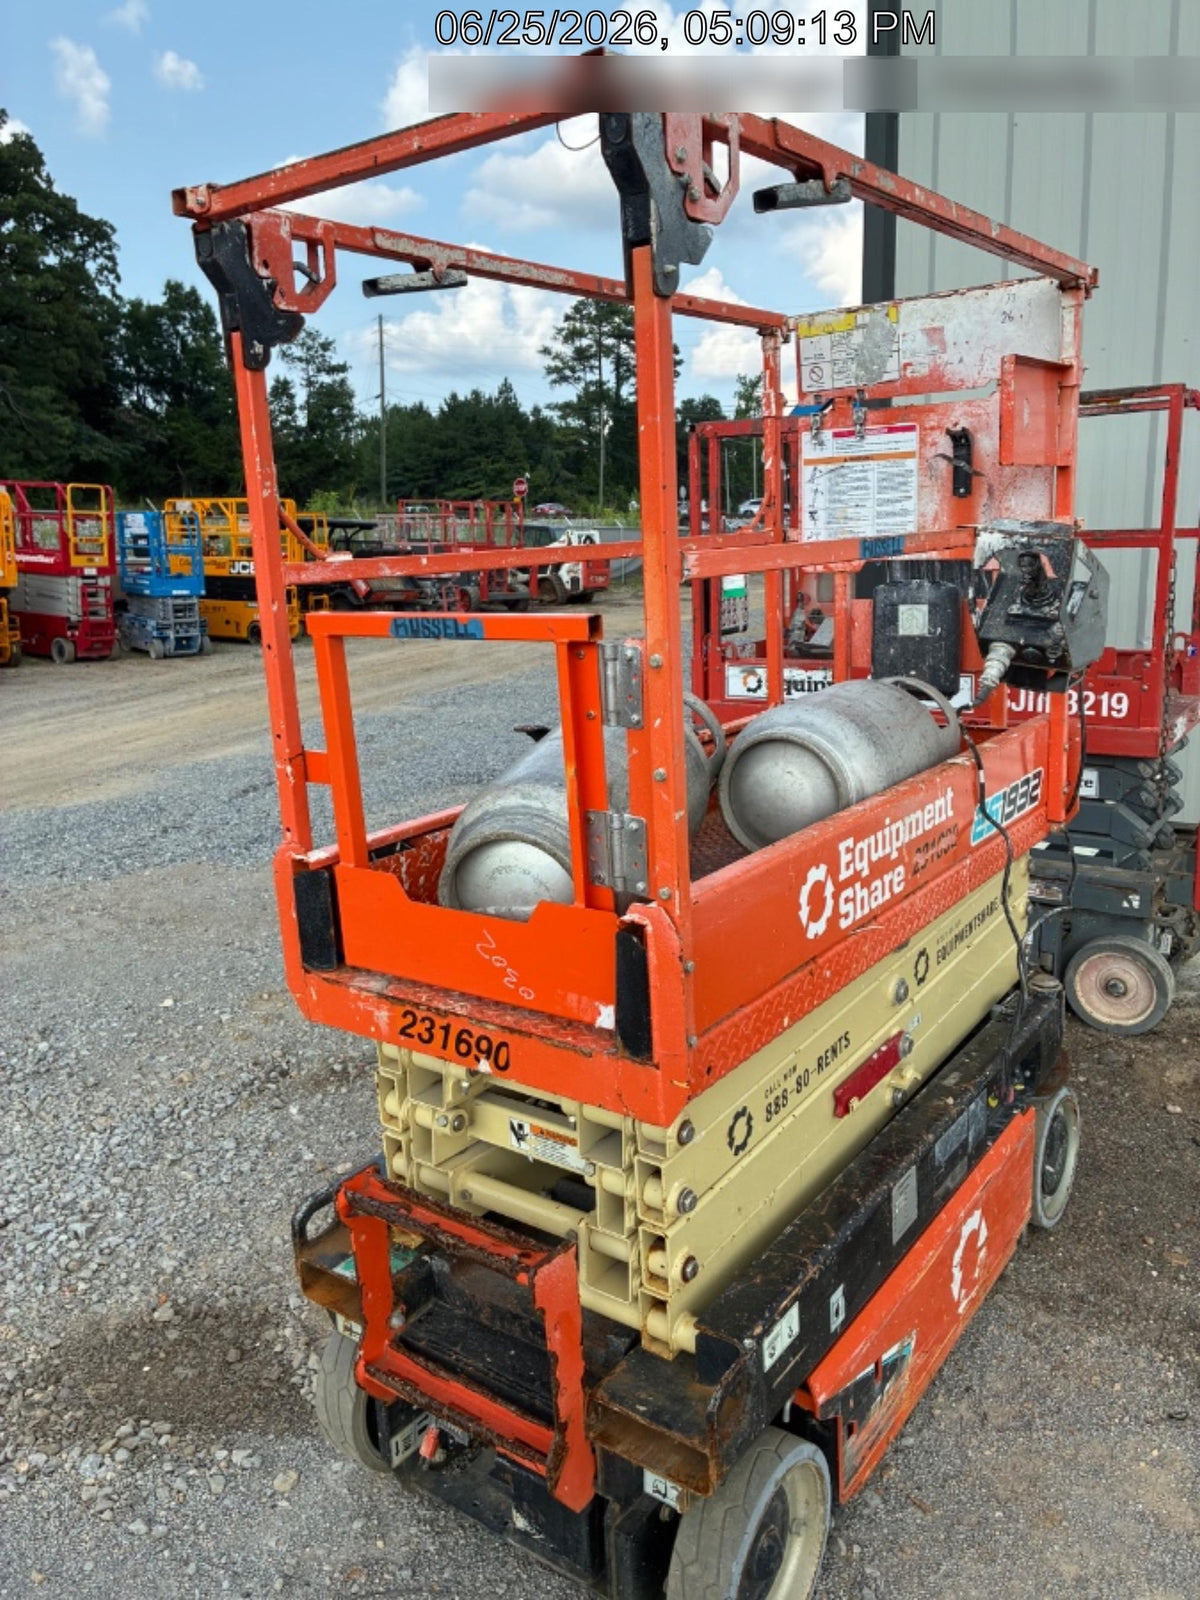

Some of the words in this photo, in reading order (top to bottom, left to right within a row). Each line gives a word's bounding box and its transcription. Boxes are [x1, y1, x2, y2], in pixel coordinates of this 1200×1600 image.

[838, 786, 955, 882] Equipment
[838, 863, 906, 930] Share
[398, 1008, 511, 1072] 231690
[765, 1030, 851, 1123] 888-80-RENTS
